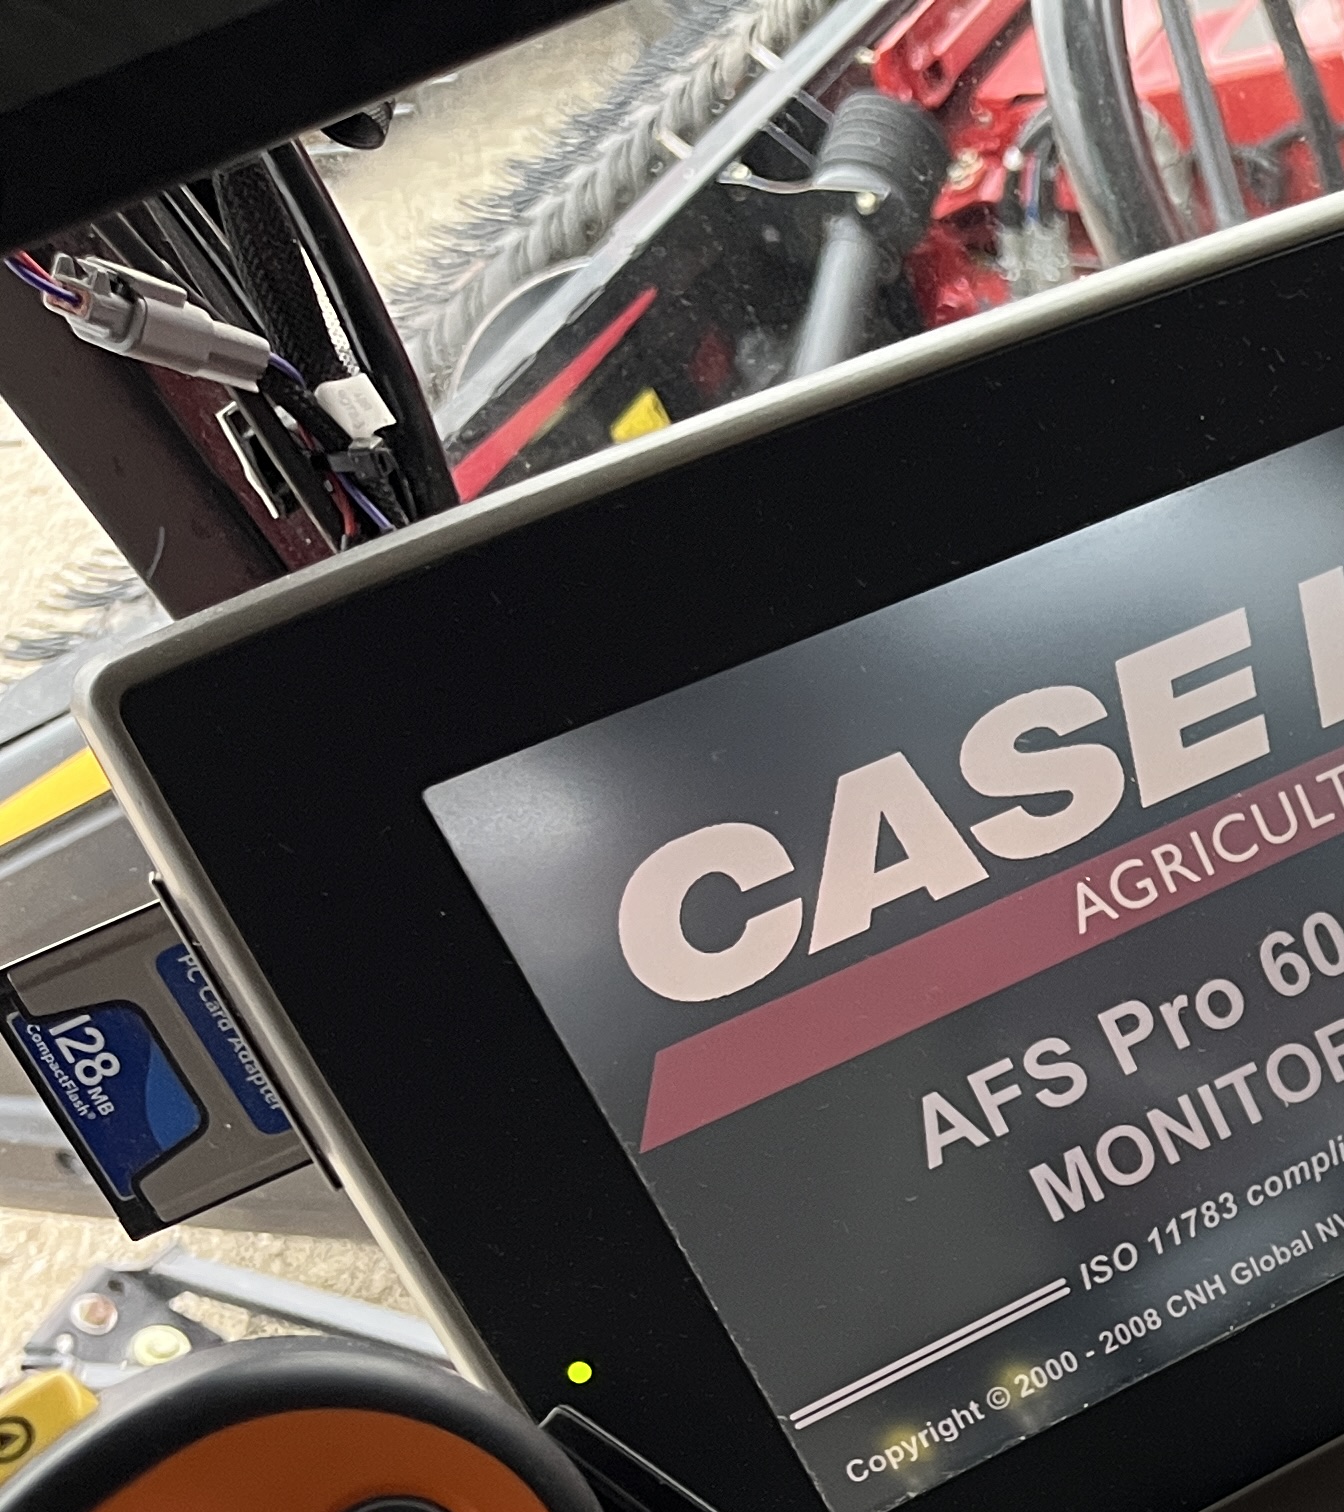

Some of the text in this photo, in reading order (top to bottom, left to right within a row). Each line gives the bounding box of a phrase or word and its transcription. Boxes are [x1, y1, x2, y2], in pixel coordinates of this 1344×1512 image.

[618, 606, 1271, 1003] CASE
[48, 1014, 121, 1116] 128 MB
[199, 985, 235, 1032] Card
[922, 1037, 1088, 1170] AFS
[1097, 978, 1245, 1076] Pro
[1080, 1242, 1138, 1290] ISO
[1147, 1191, 1239, 1256] 11783
[846, 1400, 986, 1483] Copyright
[1013, 1350, 1079, 1398] 2000
[1098, 1308, 1162, 1355] 2008
[1166, 1274, 1227, 1319] CNH
[1230, 1229, 1314, 1286] Global
